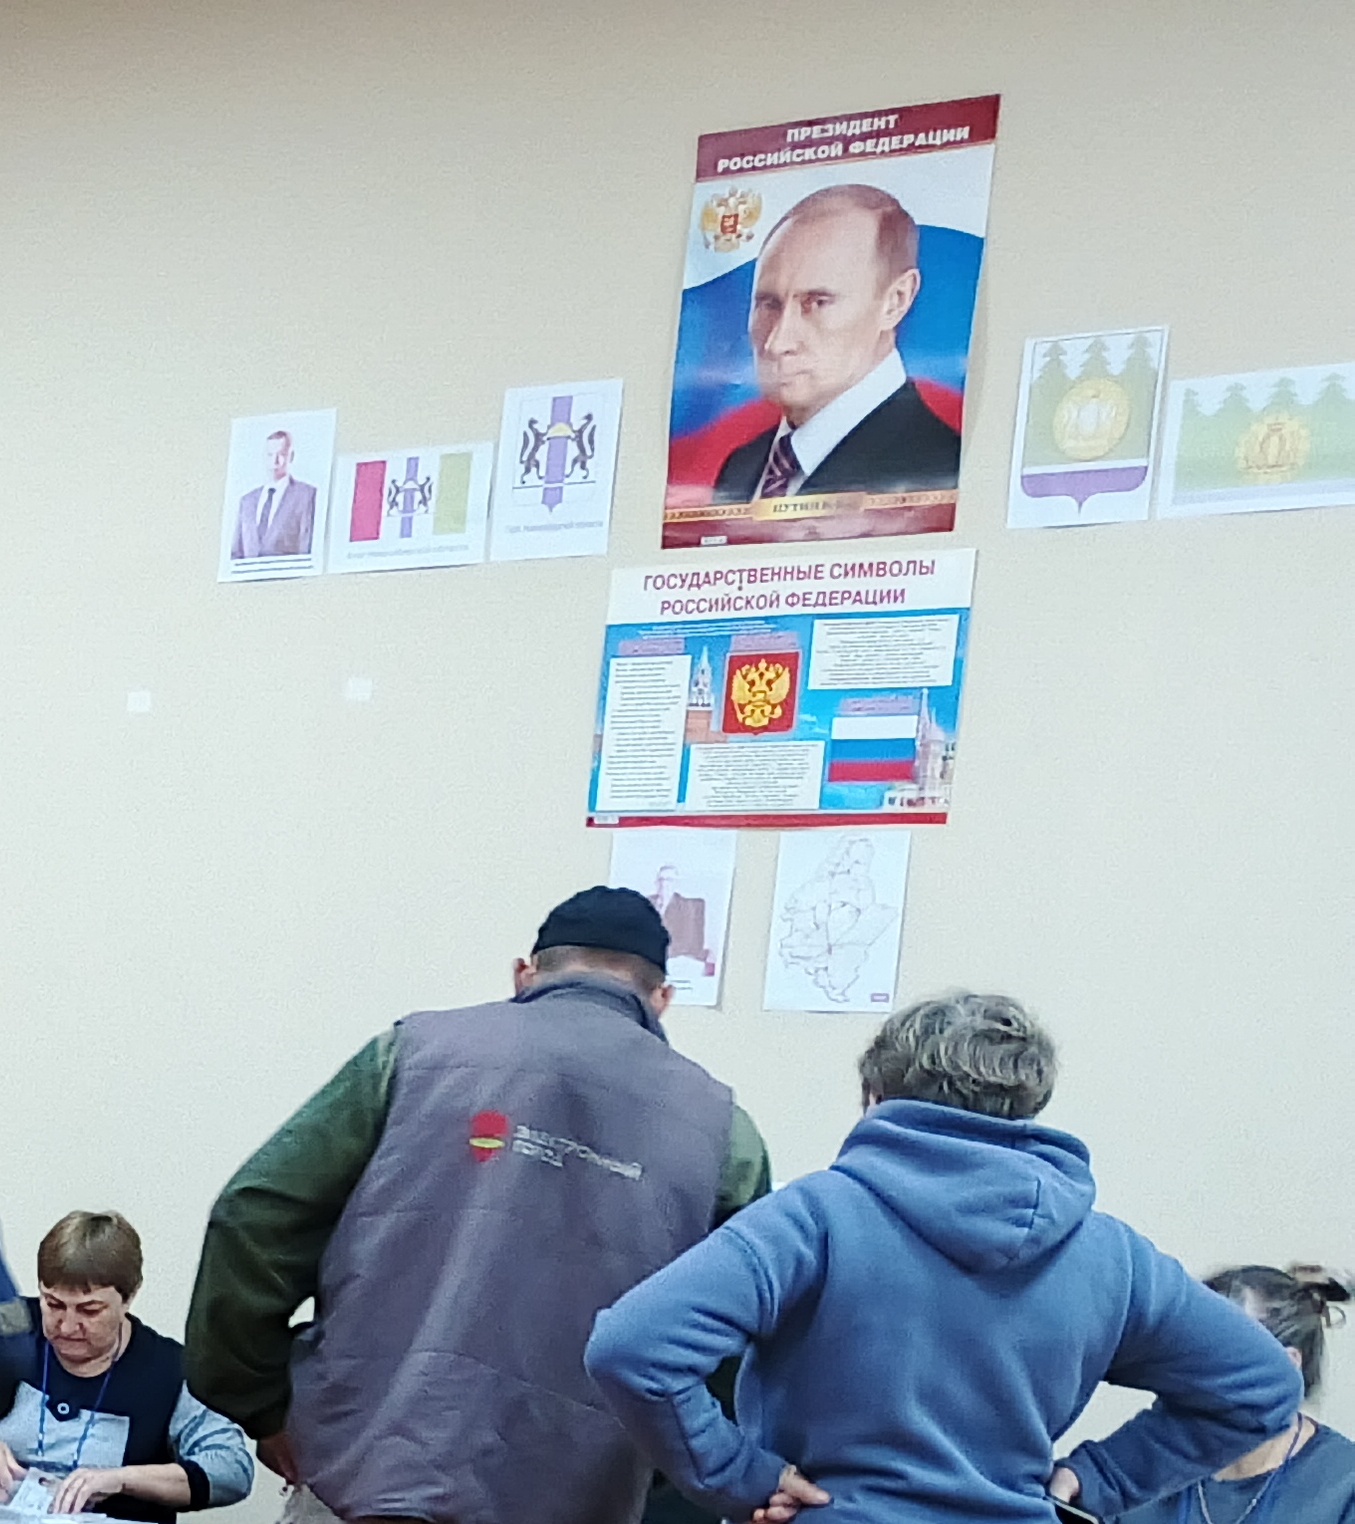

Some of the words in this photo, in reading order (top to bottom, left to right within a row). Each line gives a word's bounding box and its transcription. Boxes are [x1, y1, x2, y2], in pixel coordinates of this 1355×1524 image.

[786, 114, 898, 142] ПРЕЗИДЕНТ
[717, 140, 843, 173] РОССИЙСКОЙ
[848, 126, 971, 156] ФЕДЕРАЦИИ
[643, 563, 826, 592] ГОСУДАРСТВЕННЫЕ
[829, 559, 936, 580] СИМВОЛЫ
[660, 590, 781, 616] РОССИЙСКОЙ
[784, 588, 906, 608] ФЕДЕРАЦИИ
